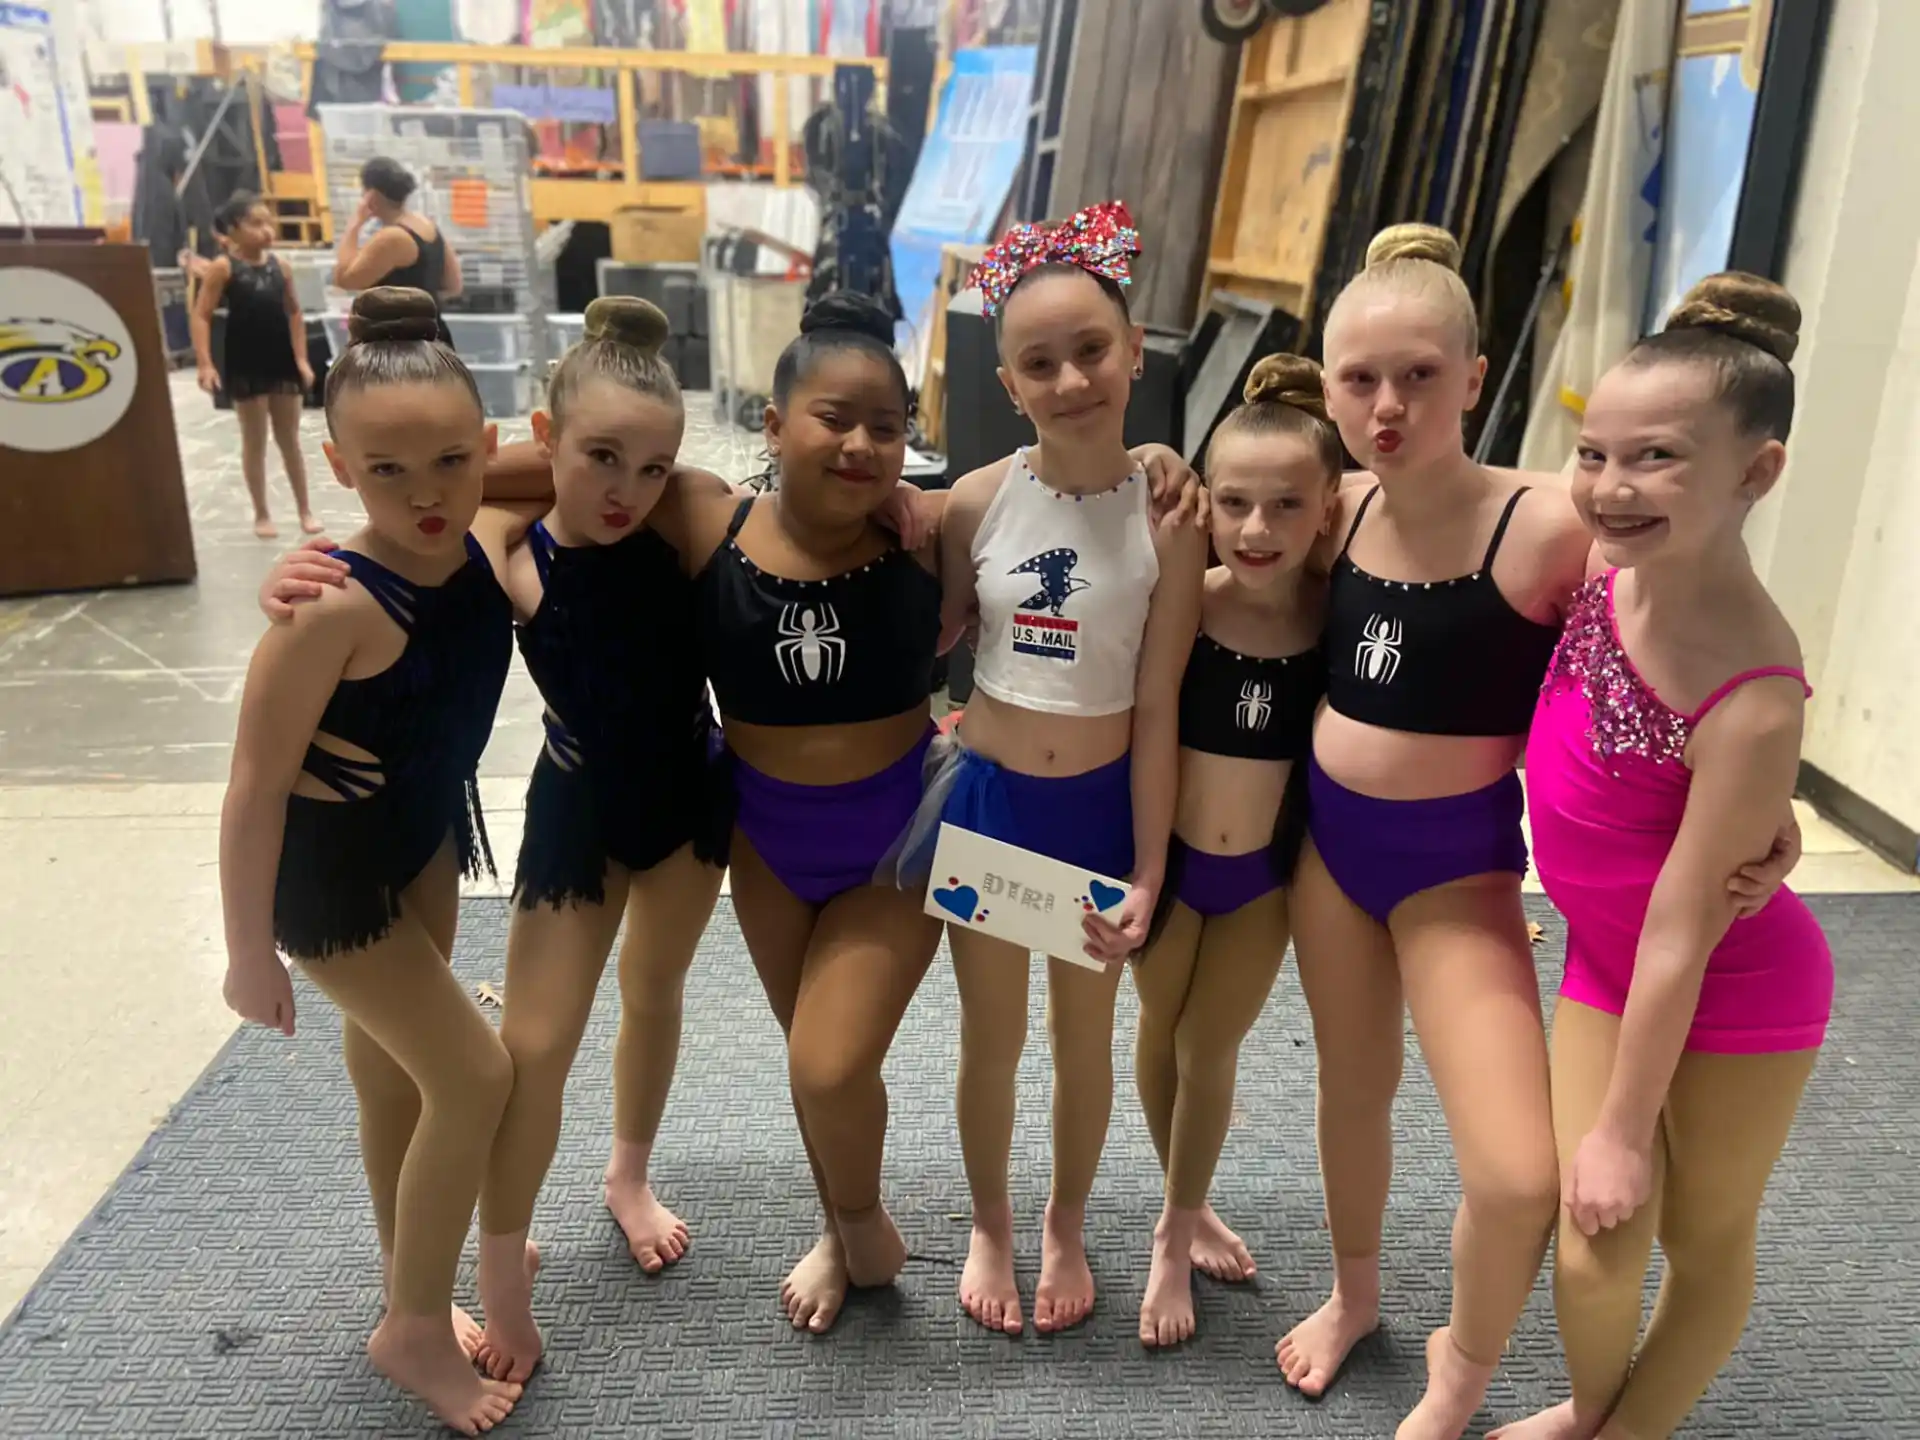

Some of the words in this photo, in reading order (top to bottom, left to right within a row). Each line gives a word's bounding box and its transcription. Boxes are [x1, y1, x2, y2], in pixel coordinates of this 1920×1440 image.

[19, 357, 66, 397] A
[1012, 626, 1037, 643] U.S.
[1041, 631, 1076, 648] MAIL
